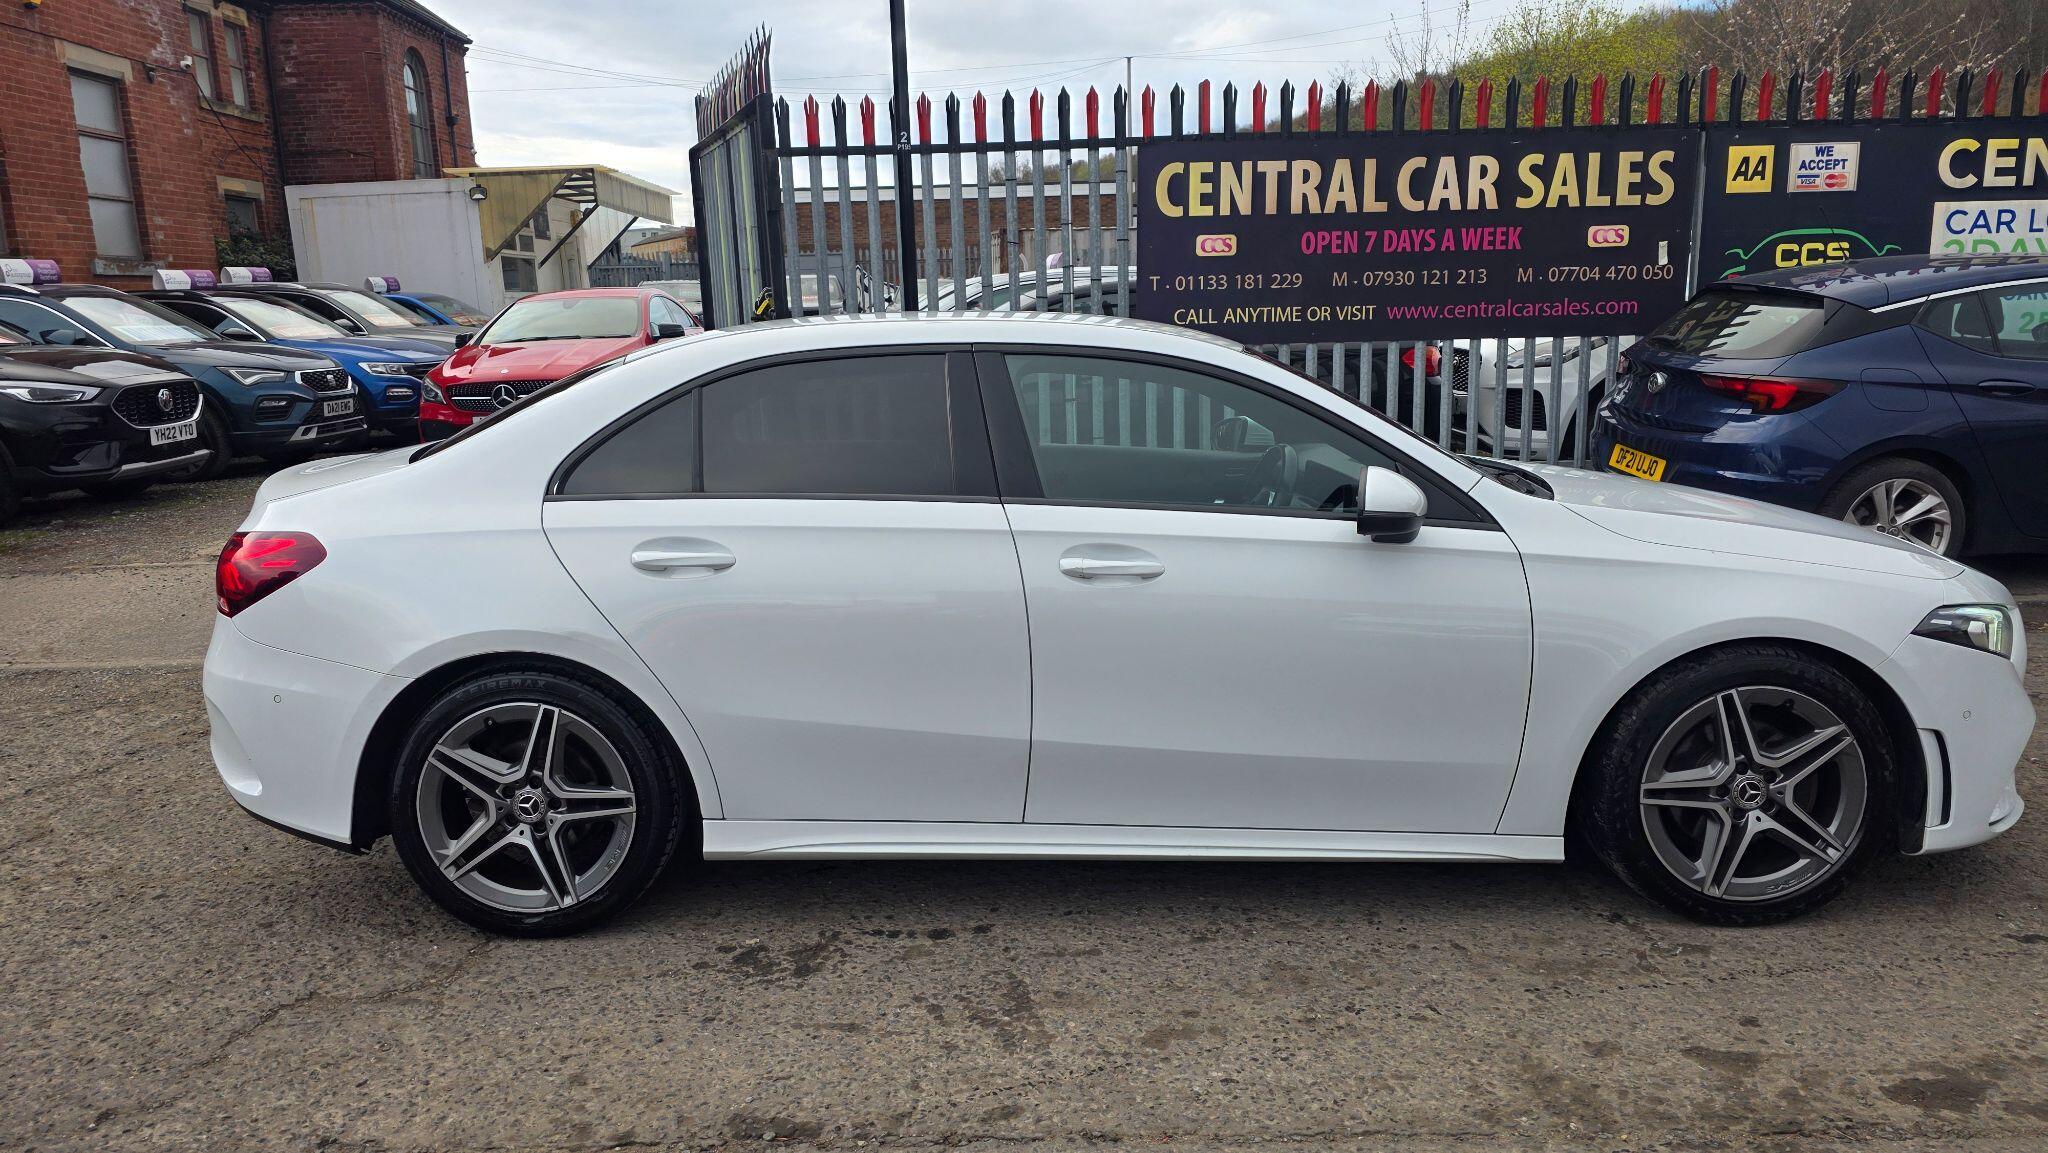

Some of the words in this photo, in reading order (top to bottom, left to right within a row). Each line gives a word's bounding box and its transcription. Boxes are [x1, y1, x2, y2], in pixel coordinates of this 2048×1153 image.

[900, 131, 907, 143] 2
[1815, 146, 1835, 157] WE
[1731, 156, 1767, 181] AA
[1799, 159, 1848, 171] ACCEPT
[1155, 158, 1388, 218] CENTRAL
[1396, 155, 1500, 212] CAR
[1515, 150, 1676, 209] SALES
[1946, 208, 2016, 234] CAR
[2029, 208, 2048, 233] L
[1301, 230, 1358, 255] OPEN
[1364, 230, 1378, 254] 7
[1383, 229, 1436, 253] DAYS
[1440, 228, 1455, 251] A
[1461, 226, 1523, 250] WEEK
[1592, 228, 1625, 244] CCS
[1200, 238, 1233, 254] CCS
[1775, 241, 1850, 268] CCS
[1175, 275, 1228, 291] 01133
[1235, 274, 1263, 290] 181
[1270, 273, 1303, 289] 229
[1363, 270, 1415, 286] 07930
[1421, 269, 1448, 285] 121
[1456, 269, 1487, 284] 213
[1548, 266, 1601, 282] 07704
[1605, 265, 1637, 281] 470
[1642, 264, 1674, 280] 050
[1174, 308, 1218, 325] CALL
[1223, 306, 1302, 324] ANYTIME
[1307, 306, 1331, 322] OR
[1336, 305, 1376, 321] VISIT
[1387, 298, 1638, 320] www.centralcarsales.com
[154, 427, 176, 443] YH22
[178, 424, 194, 438] VTO
[1616, 447, 1637, 469] DF21
[1636, 455, 1658, 477] UJO
[470, 680, 546, 694] FIREMAX
